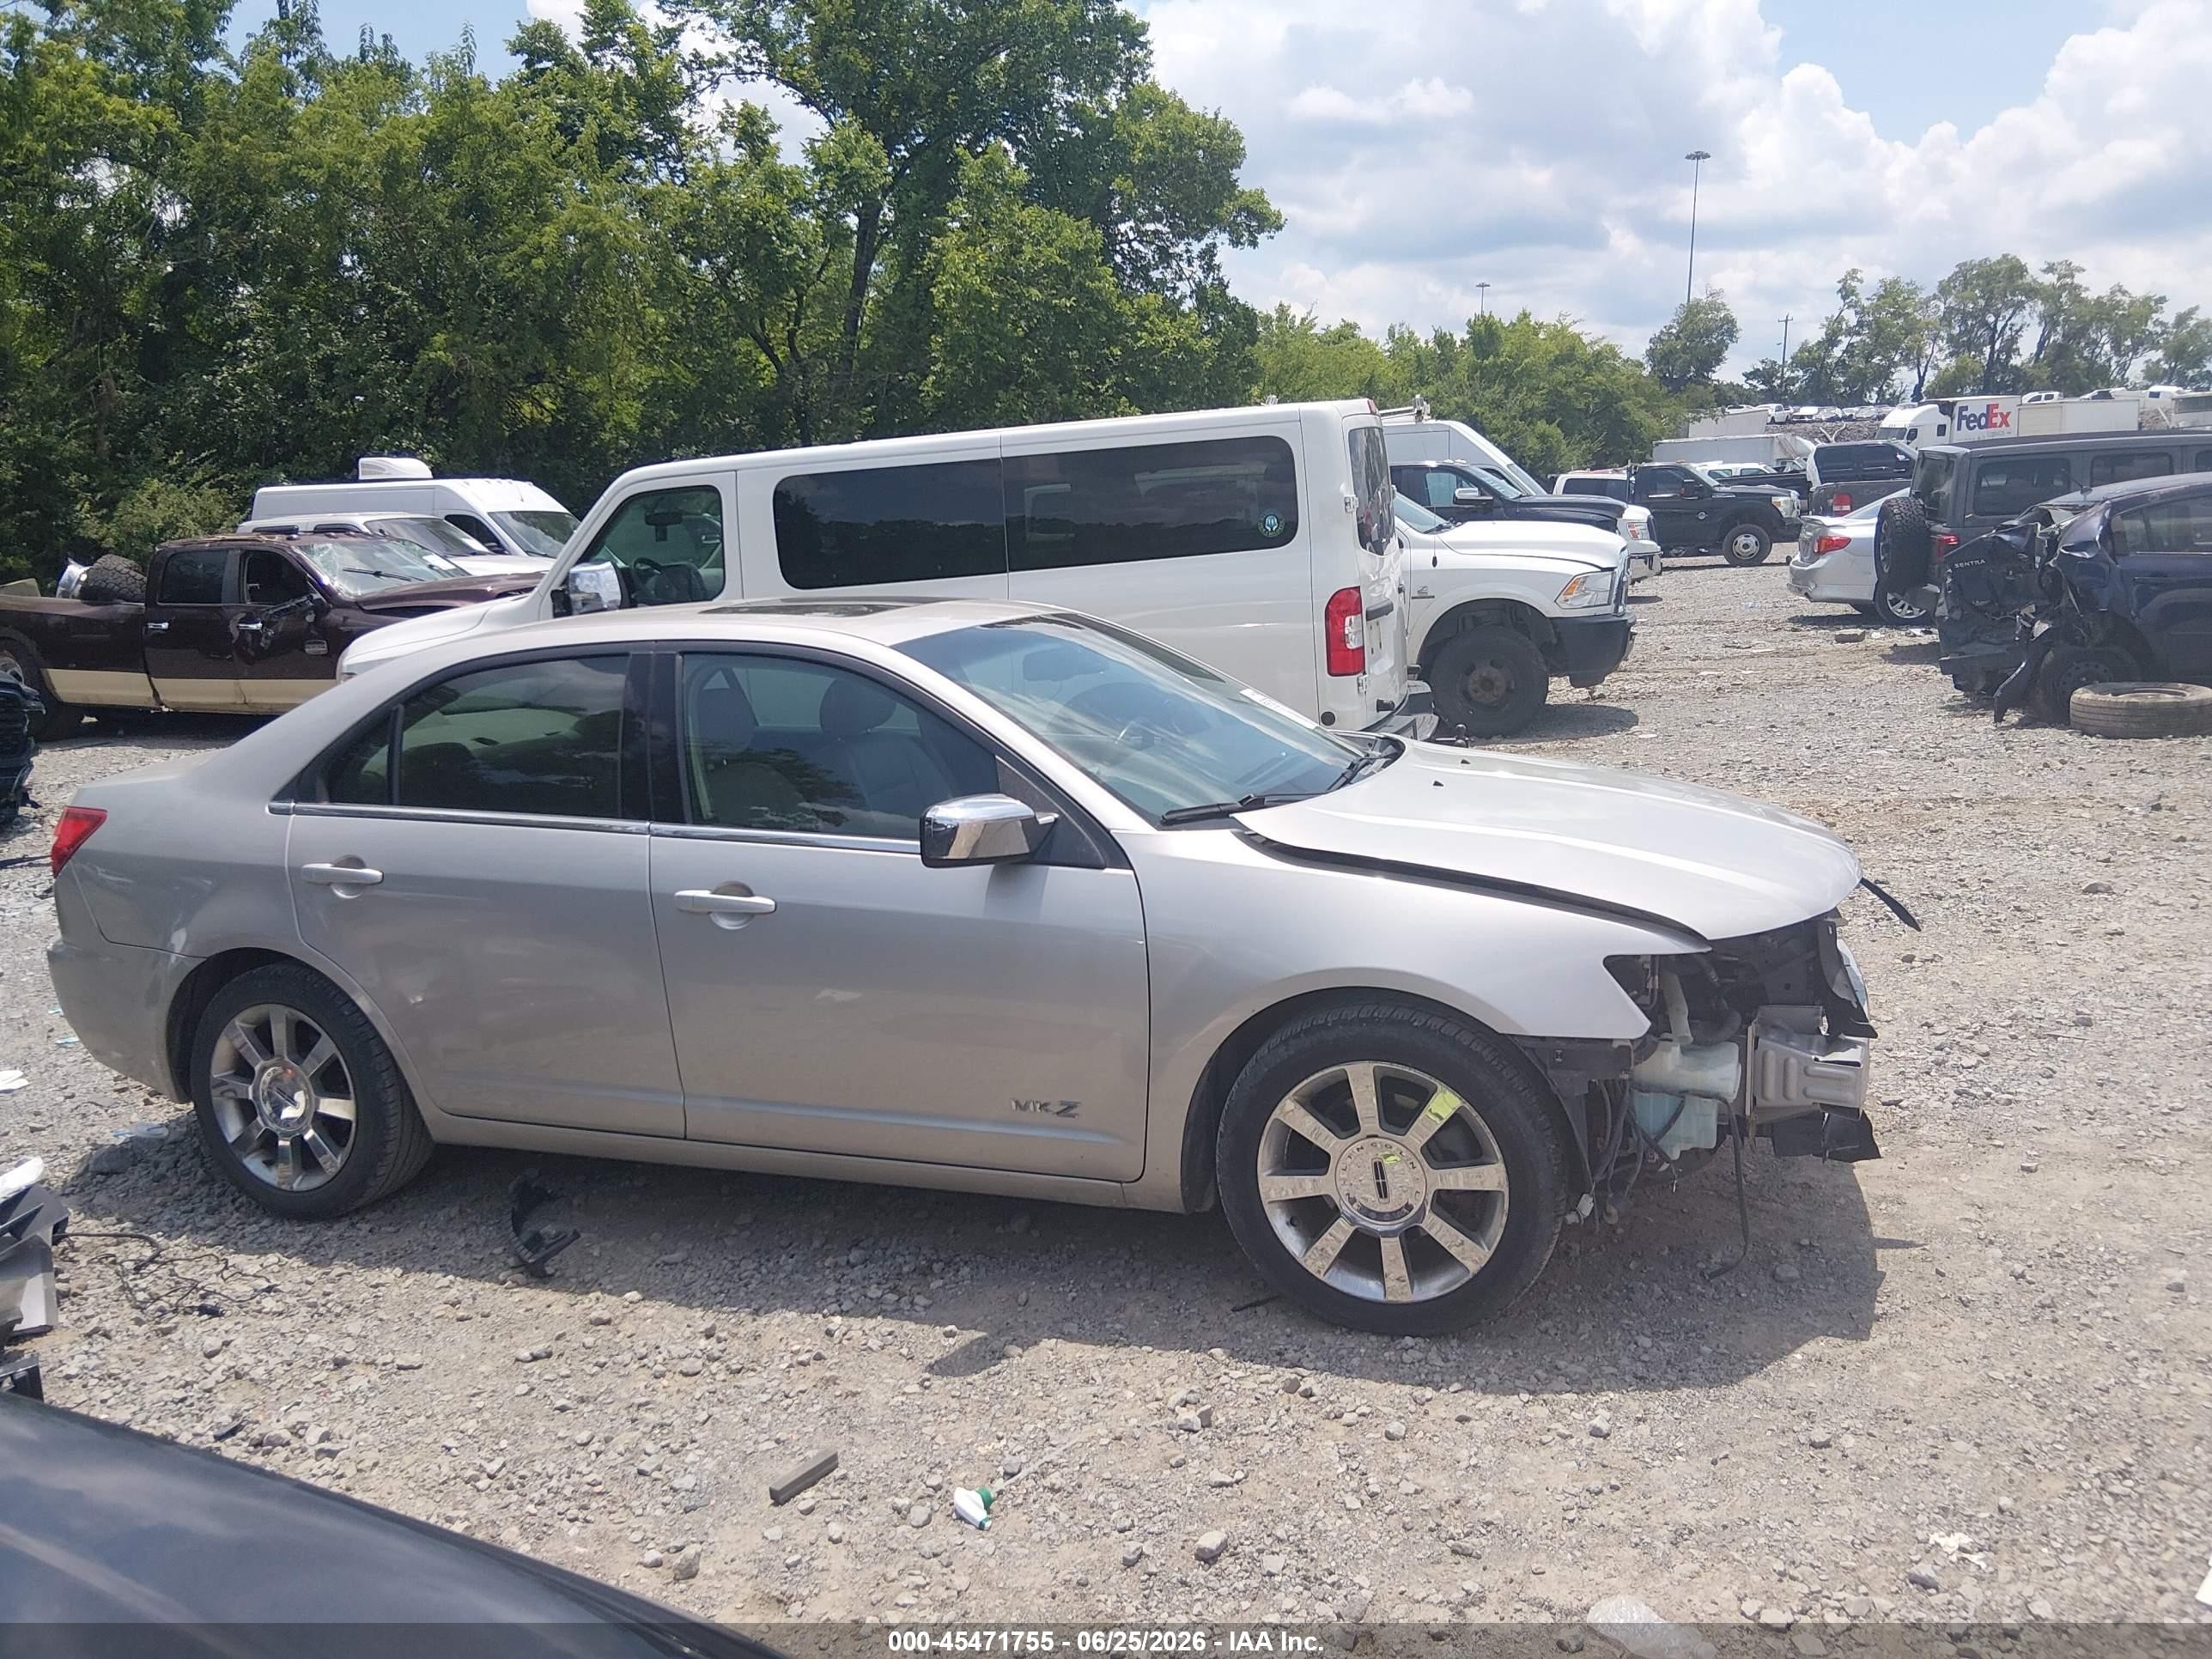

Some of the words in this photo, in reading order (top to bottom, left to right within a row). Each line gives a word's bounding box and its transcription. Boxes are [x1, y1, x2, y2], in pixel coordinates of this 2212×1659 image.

[1957, 404, 2011, 431] FedEx
[1954, 559, 1986, 568] SENTRA
[1011, 1099, 1082, 1119] MKZ
[1341, 1142, 1417, 1170] LINCOLN
